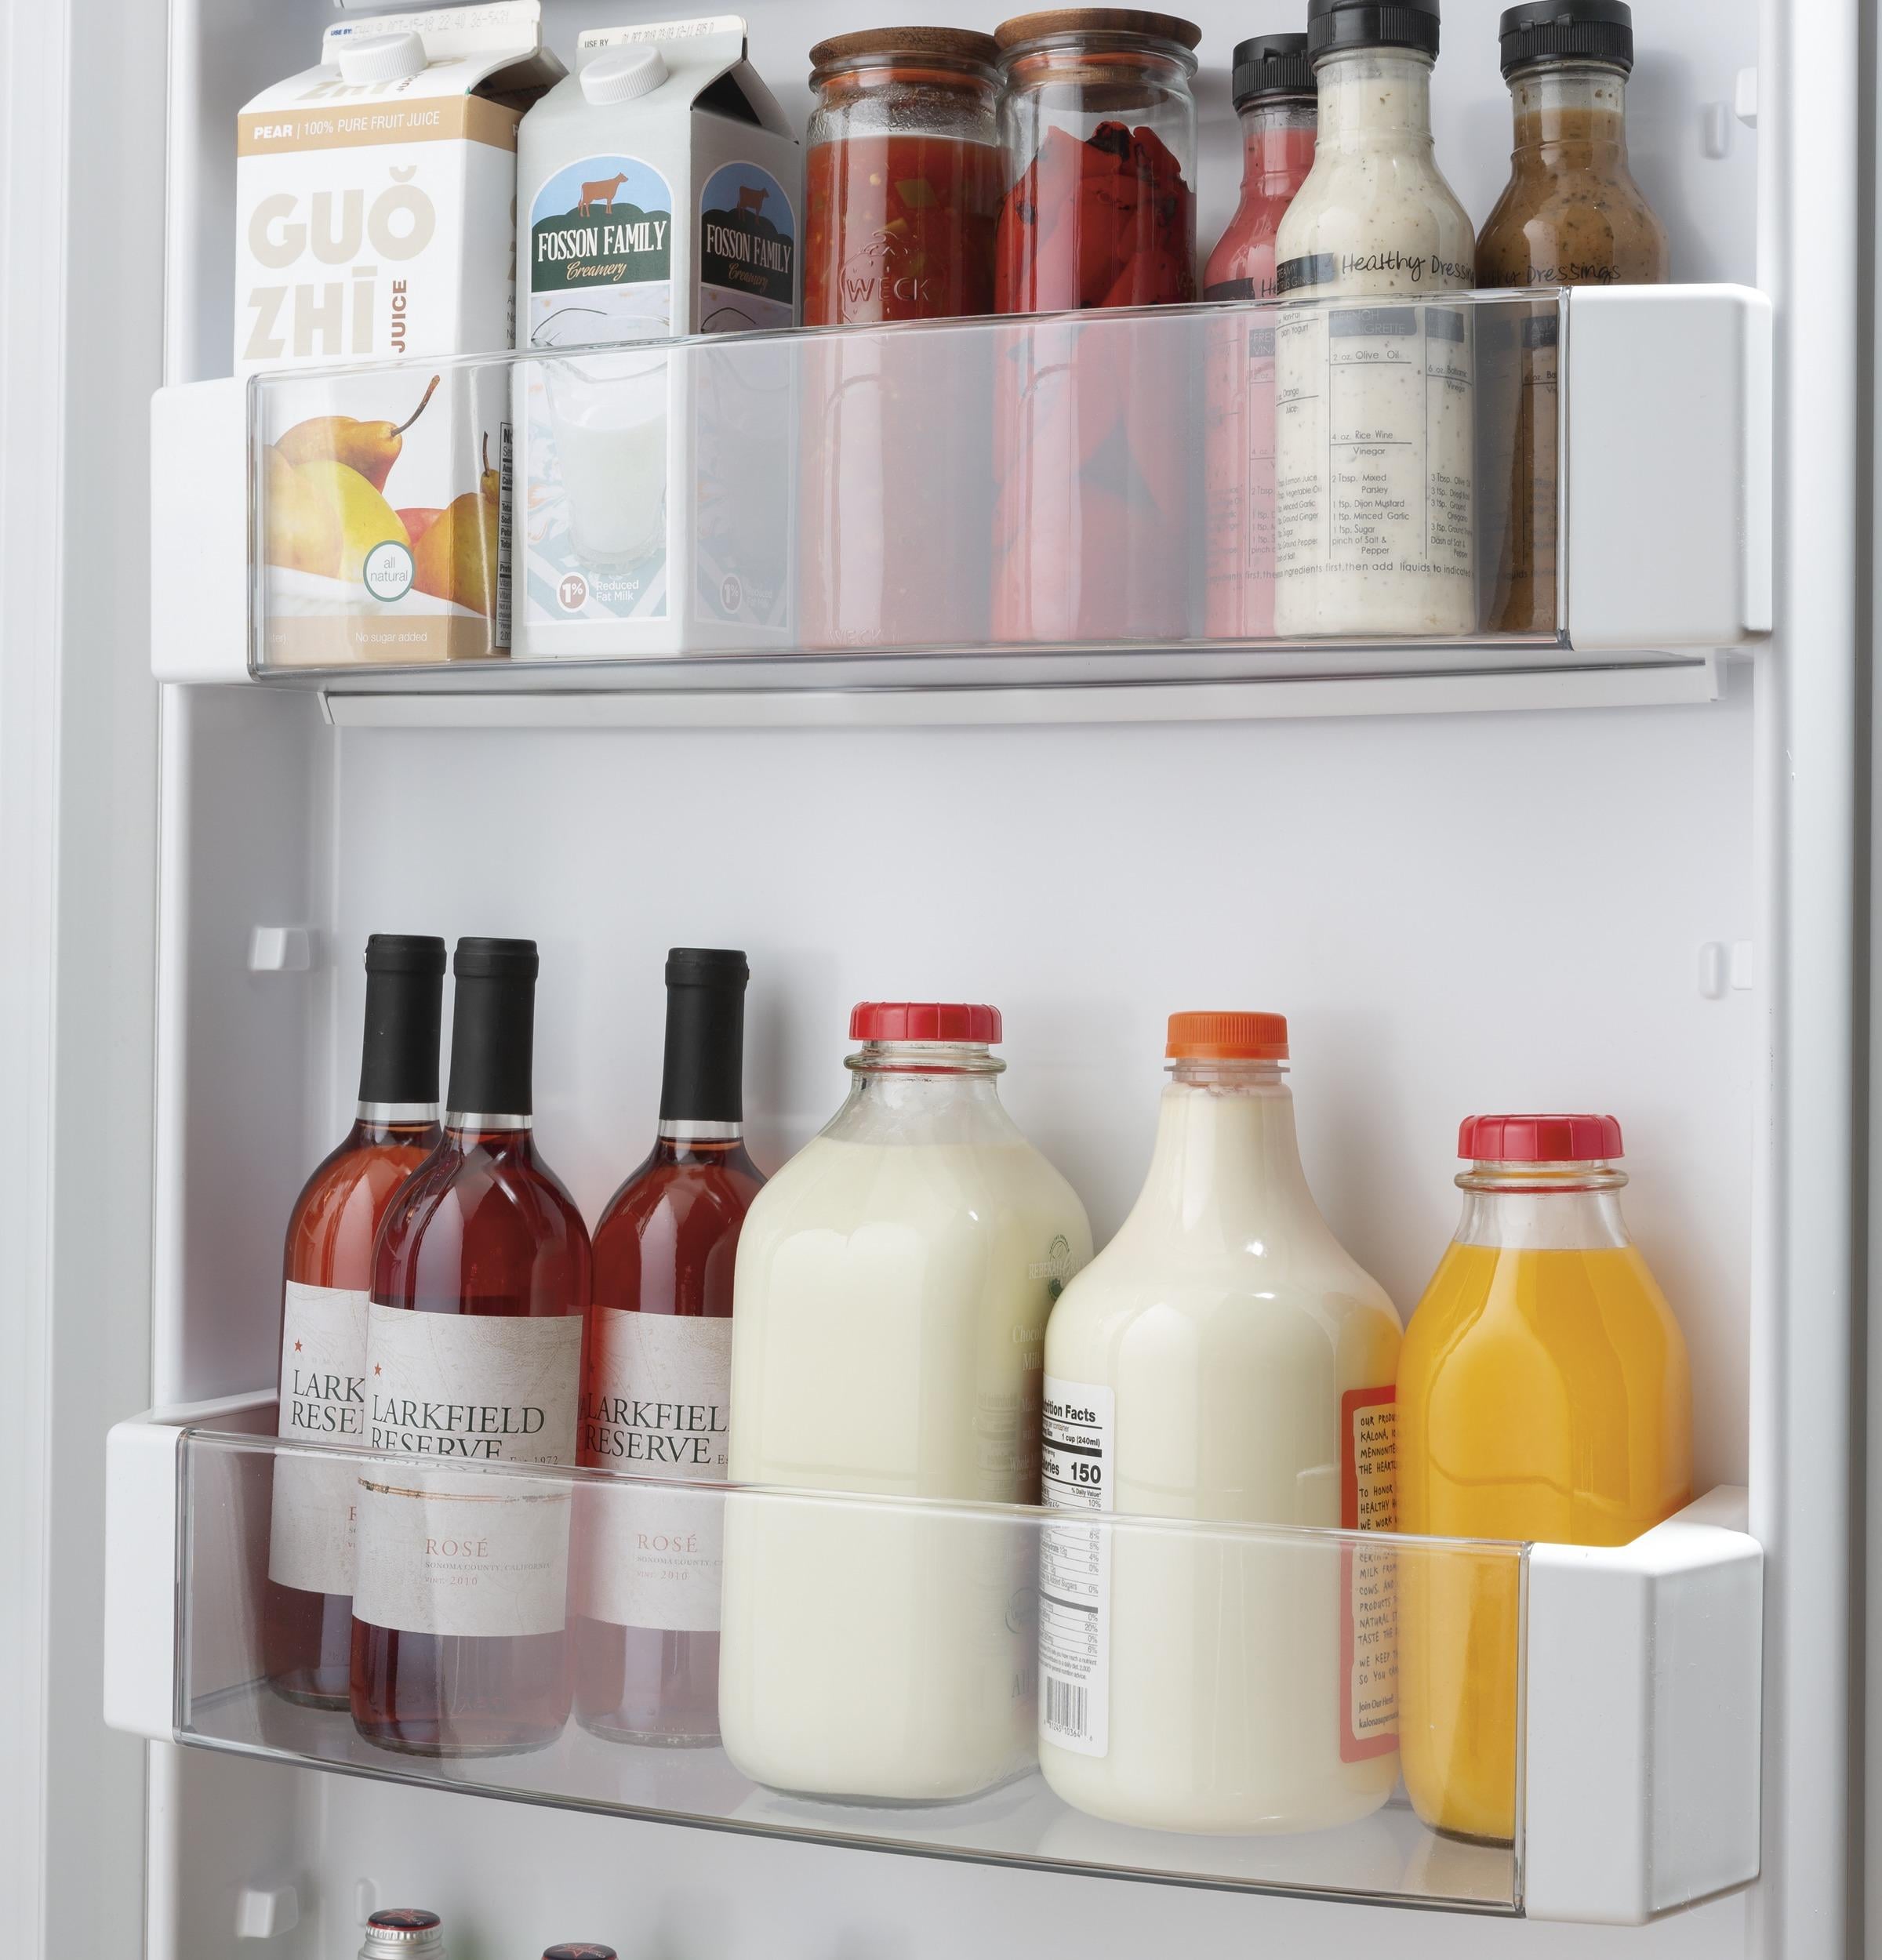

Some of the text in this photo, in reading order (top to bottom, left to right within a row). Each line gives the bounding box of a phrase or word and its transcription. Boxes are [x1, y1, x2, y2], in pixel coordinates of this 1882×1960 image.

[253, 111, 441, 140] PEAR 100% PURE FRUIT JUICE
[538, 220, 667, 263] FOSSON FAMILY
[707, 223, 791, 274] FOSSON FAMILY
[566, 260, 627, 282] Creamery
[1342, 251, 1426, 282] Healthy
[1527, 262, 1622, 285] Dressings
[728, 262, 768, 292] Creamery
[846, 278, 930, 303] WECK
[391, 280, 407, 353] JUICE
[1355, 350, 1380, 360] Olive
[1386, 350, 1401, 359] Oil
[1355, 430, 1371, 439] Rice
[1375, 430, 1393, 439] Wine
[1353, 446, 1386, 457] Vinegar
[1332, 473, 1386, 484] 2 Tbsp. Mixed
[1361, 485, 1389, 495] Parsley
[1299, 499, 1317, 510] Garlic
[1339, 499, 1352, 509] tsp.
[1354, 499, 1373, 509] Dijon
[1374, 499, 1405, 509] Mustard
[1299, 512, 1320, 523] Ginger
[1339, 512, 1352, 521] tsp.
[1353, 512, 1383, 521] Minced
[1386, 511, 1412, 521] Garlic
[1339, 524, 1353, 534] tsp.
[1354, 524, 1375, 535] Sugar
[1332, 536, 1353, 546] pinch
[1354, 535, 1363, 544] of
[1364, 535, 1379, 544] Salt
[1361, 546, 1390, 556] Pepper
[383, 557, 395, 569] all
[1284, 564, 1323, 579] ingredients
[1345, 561, 1368, 572] then
[1372, 561, 1393, 572] add
[1400, 561, 1430, 573] liquids
[1433, 564, 1442, 573] to
[370, 569, 409, 583] natural
[562, 580, 640, 604] 1% Reduced
[596, 590, 634, 602] Fat Milk
[355, 632, 427, 645] No sugar added
[372, 1394, 546, 1436] LARKFIELD
[587, 1392, 729, 1433] LARKFIEL
[1066, 1404, 1095, 1423] Facts
[1361, 1416, 1374, 1427] OUR
[586, 1424, 711, 1465] RESERVE
[1066, 1435, 1075, 1445] cup
[1077, 1434, 1101, 1448] (240ml)
[1360, 1444, 1396, 1459] MENNONITE
[1071, 1461, 1101, 1484] 150
[1359, 1465, 1372, 1475] THE
[1359, 1484, 1393, 1498] TO HONOR
[1088, 1498, 1102, 1508] 10%
[1361, 1498, 1389, 1515] HEALTHY
[1360, 1514, 1393, 1530] WE WORK
[426, 1537, 489, 1559] ROSÉ
[637, 1534, 698, 1553] ROSÉ
[425, 1561, 463, 1570] SONOMA
[1360, 1566, 1379, 1579] MILK
[450, 1575, 478, 1586] 2010
[661, 1570, 688, 1581] 2010
[1360, 1596, 1391, 1613] PRODUCTS
[1360, 1613, 1390, 1628] NATURAL
[1357, 1631, 1379, 1645] TASTE
[1359, 1650, 1390, 1668] WE KEEP
[1359, 1669, 1386, 1686] SO YOU
[1358, 1699, 1372, 1715] Join
